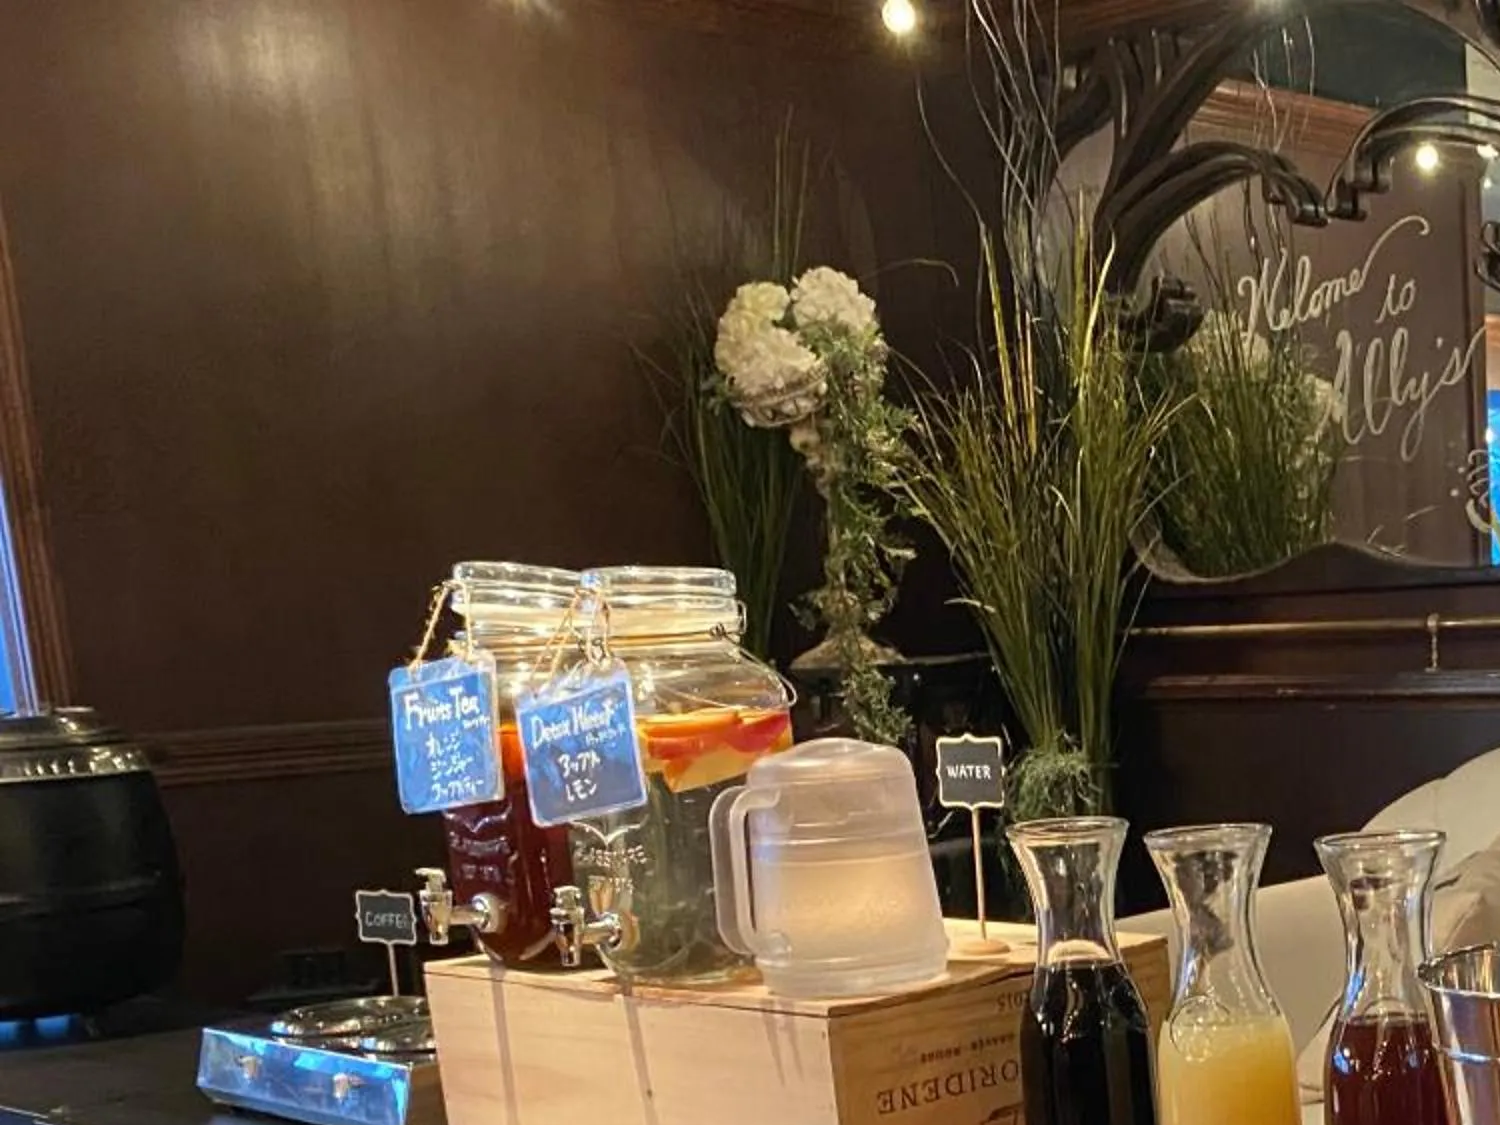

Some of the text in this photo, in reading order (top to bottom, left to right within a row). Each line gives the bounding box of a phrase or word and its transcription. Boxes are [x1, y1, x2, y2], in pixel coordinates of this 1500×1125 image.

[1375, 274, 1416, 323] to
[449, 683, 480, 720] Tea
[946, 764, 991, 780] WATER
[565, 778, 598, 802] レモン
